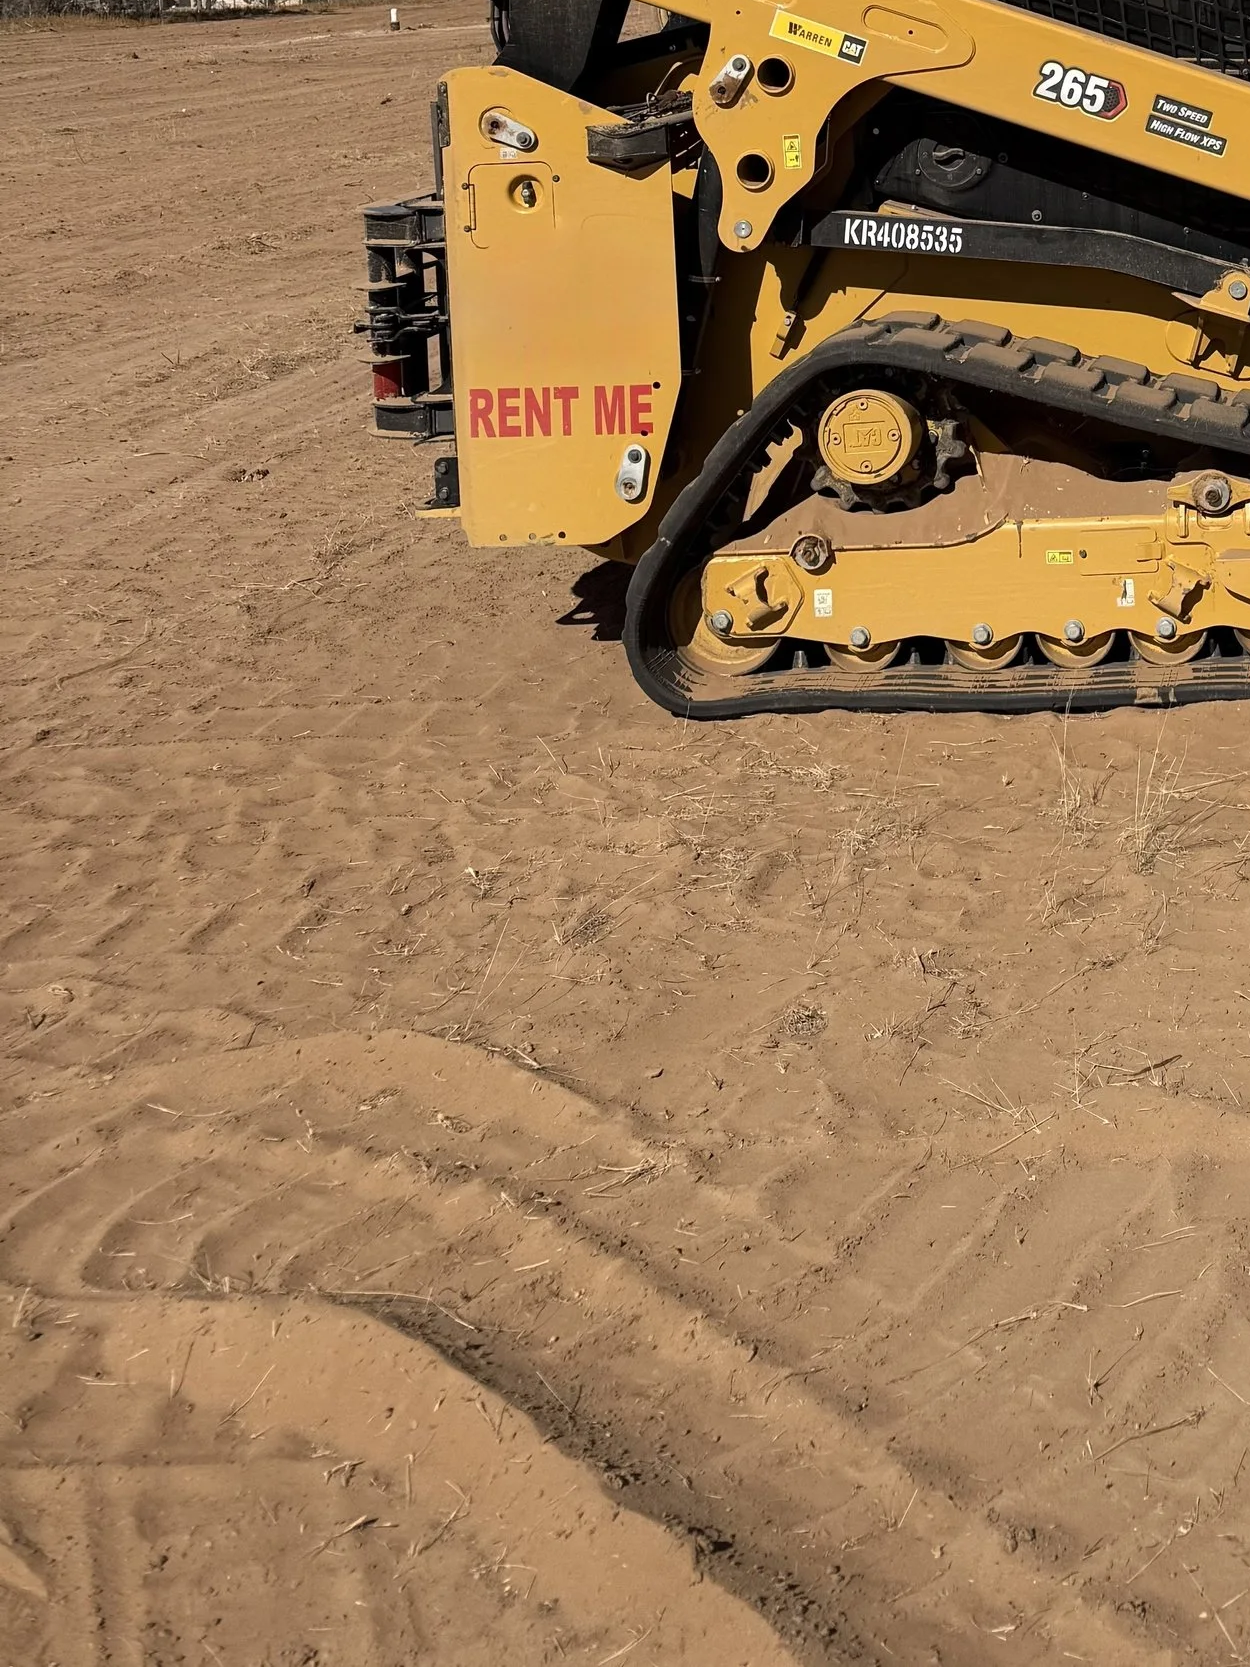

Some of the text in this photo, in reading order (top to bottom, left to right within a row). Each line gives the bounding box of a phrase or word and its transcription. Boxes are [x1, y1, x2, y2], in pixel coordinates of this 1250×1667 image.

[788, 21, 864, 57] WARREN CAT
[1036, 61, 1110, 114] 265
[1200, 135, 1223, 150] XPS
[844, 218, 963, 254] KR408535
[469, 384, 654, 439] RENT ME
